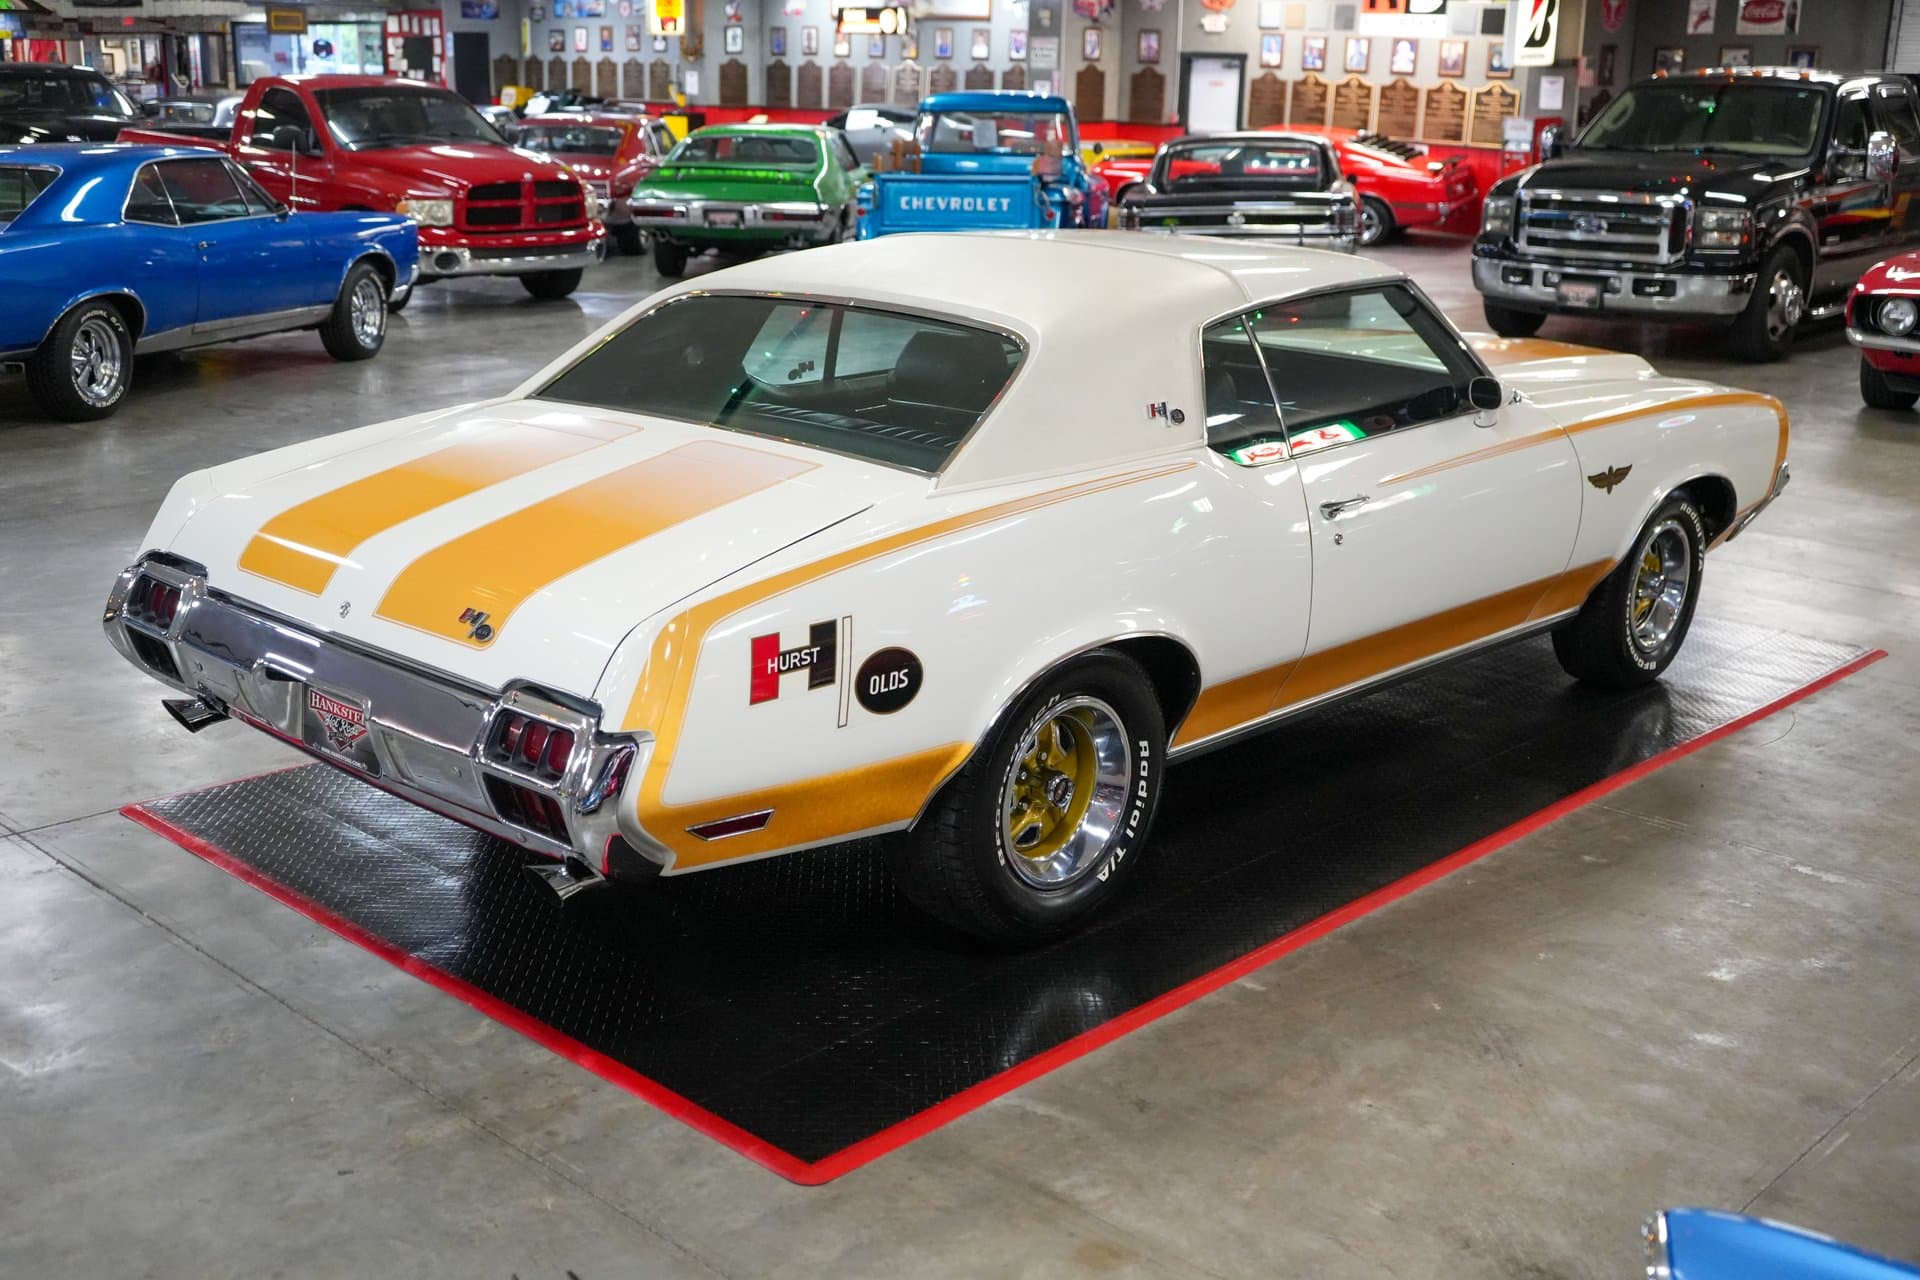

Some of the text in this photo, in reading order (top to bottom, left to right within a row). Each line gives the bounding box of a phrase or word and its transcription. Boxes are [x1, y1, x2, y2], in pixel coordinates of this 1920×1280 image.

[900, 195, 1011, 212] CHEVROLET
[767, 647, 821, 675] HURST
[869, 668, 909, 695] OLDS
[1096, 739, 1150, 882] Radial T/A
